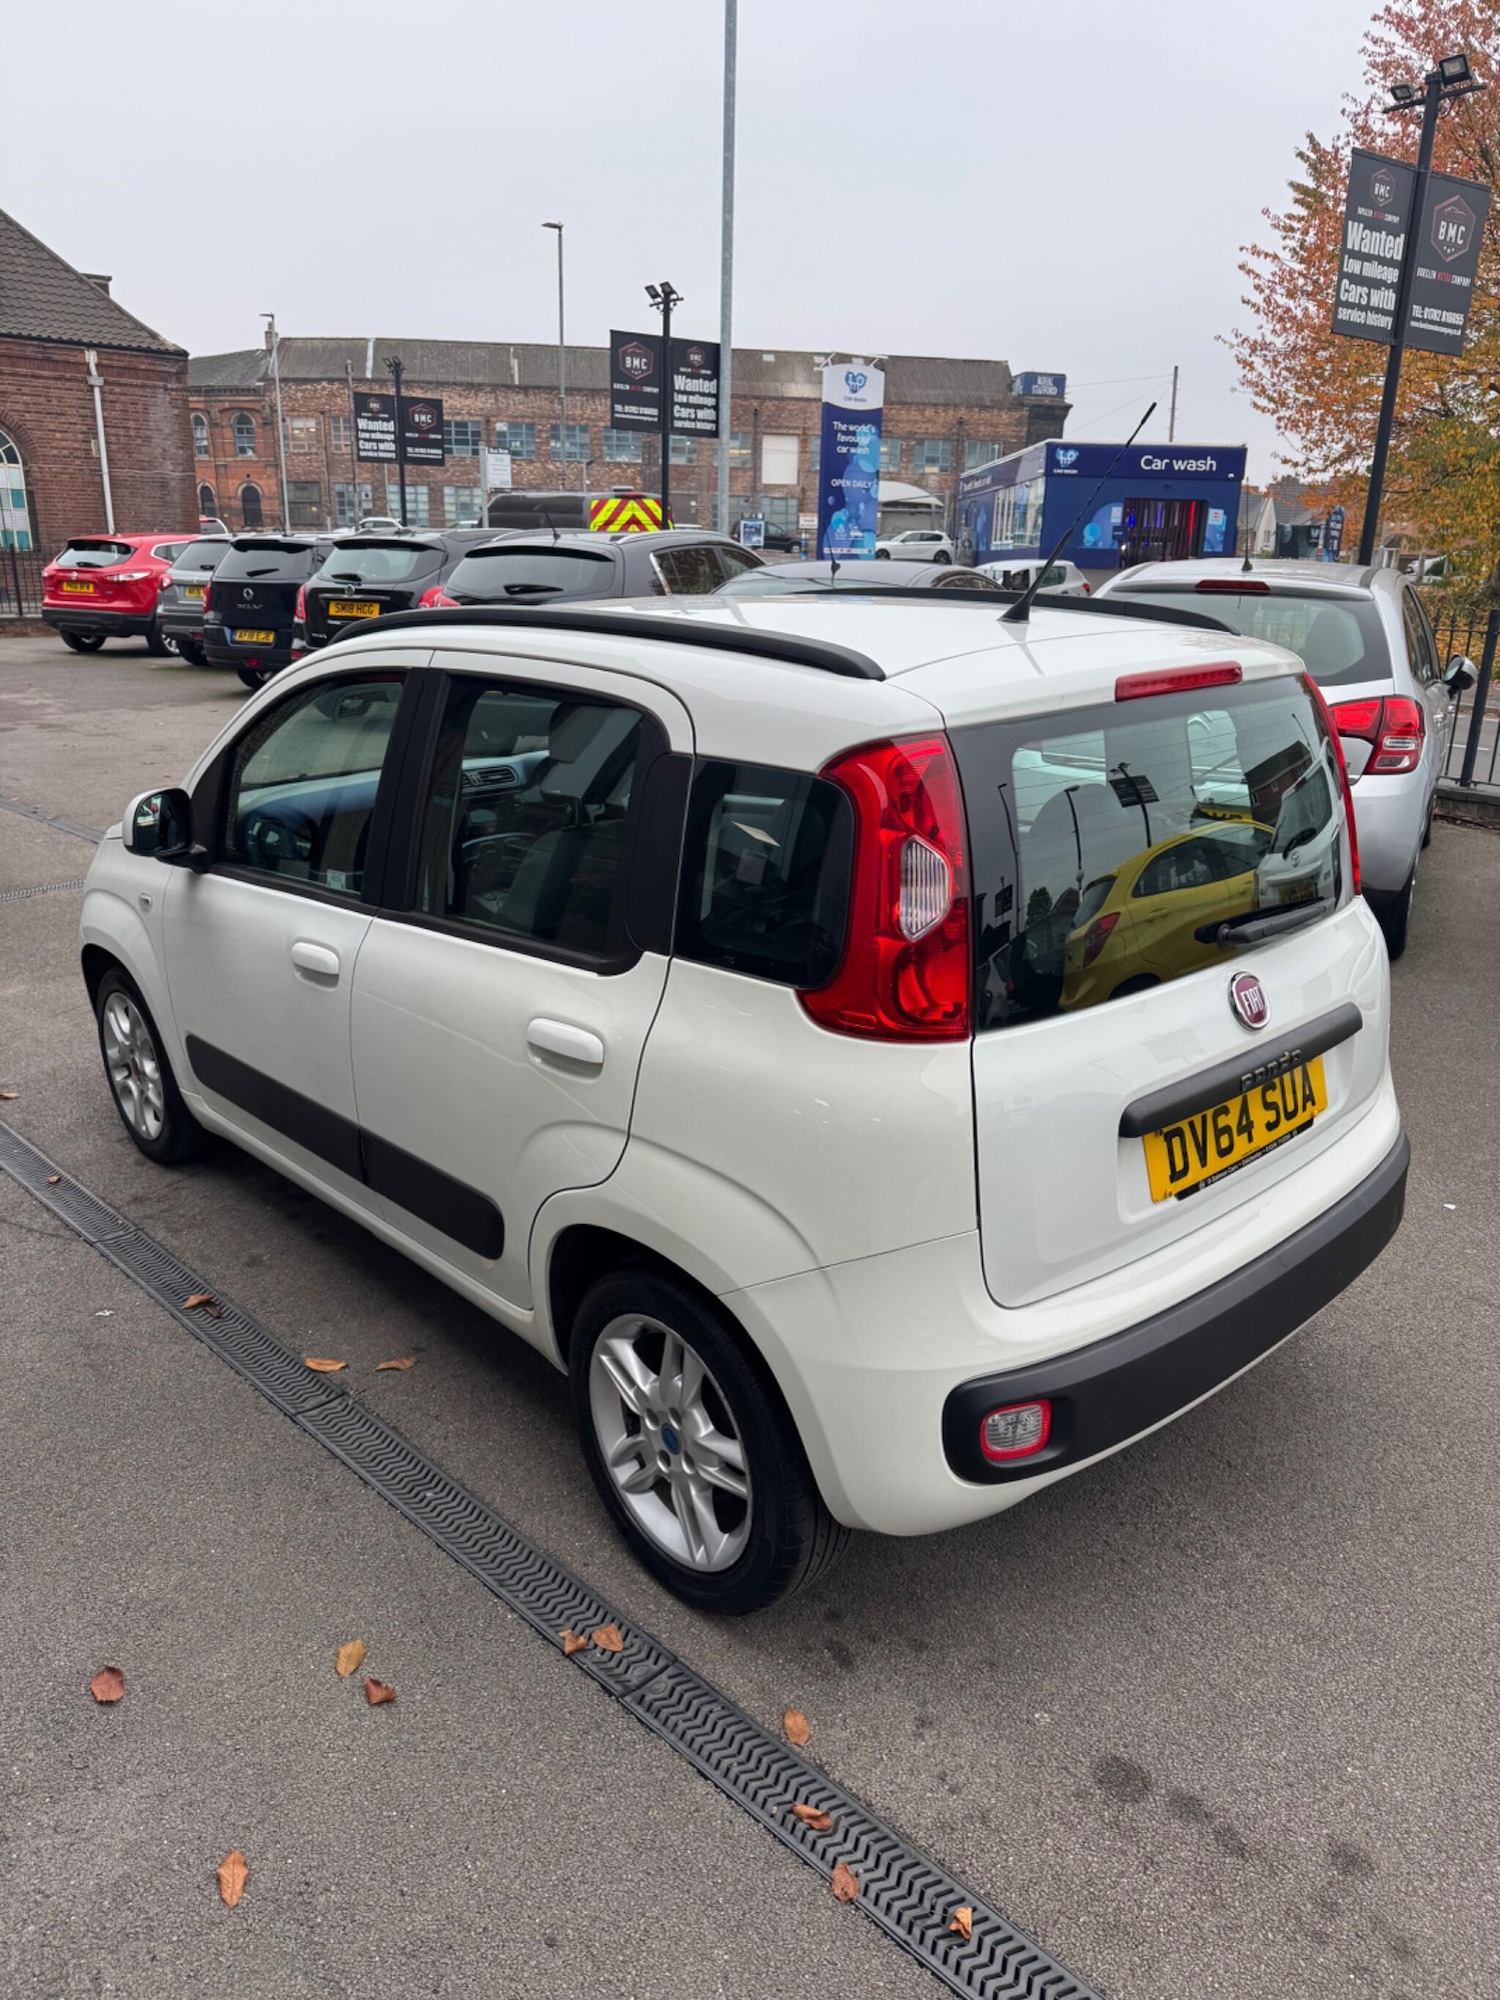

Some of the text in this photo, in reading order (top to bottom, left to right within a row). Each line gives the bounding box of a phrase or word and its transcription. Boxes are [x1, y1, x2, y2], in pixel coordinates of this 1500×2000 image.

[1374, 182, 1391, 198] BMC
[1346, 220, 1405, 261] Wanted
[1437, 220, 1466, 245] BMC
[1343, 254, 1400, 284] Low mileage
[1340, 278, 1396, 311] Cars with
[1337, 306, 1394, 330] service history
[625, 356, 648, 369] BMC
[673, 374, 717, 394] Wanted
[673, 392, 716, 406] Low mileage
[414, 413, 432, 423] BMC
[673, 404, 695, 419] Cars
[696, 408, 716, 420] with
[357, 418, 395, 432] Wanted
[673, 419, 716, 431] service history
[832, 421, 876, 433] The world's
[358, 439, 378, 450] Cars
[378, 441, 396, 451] with
[836, 445, 870, 455] car wash
[1140, 454, 1217, 471] Car wash
[831, 478, 872, 488] OPEN DAILY
[335, 602, 374, 615] SM18 HCG
[1240, 985, 1264, 1016] FIAT
[1240, 1049, 1302, 1092] panda
[1163, 1065, 1316, 1184] DV64 SUA
